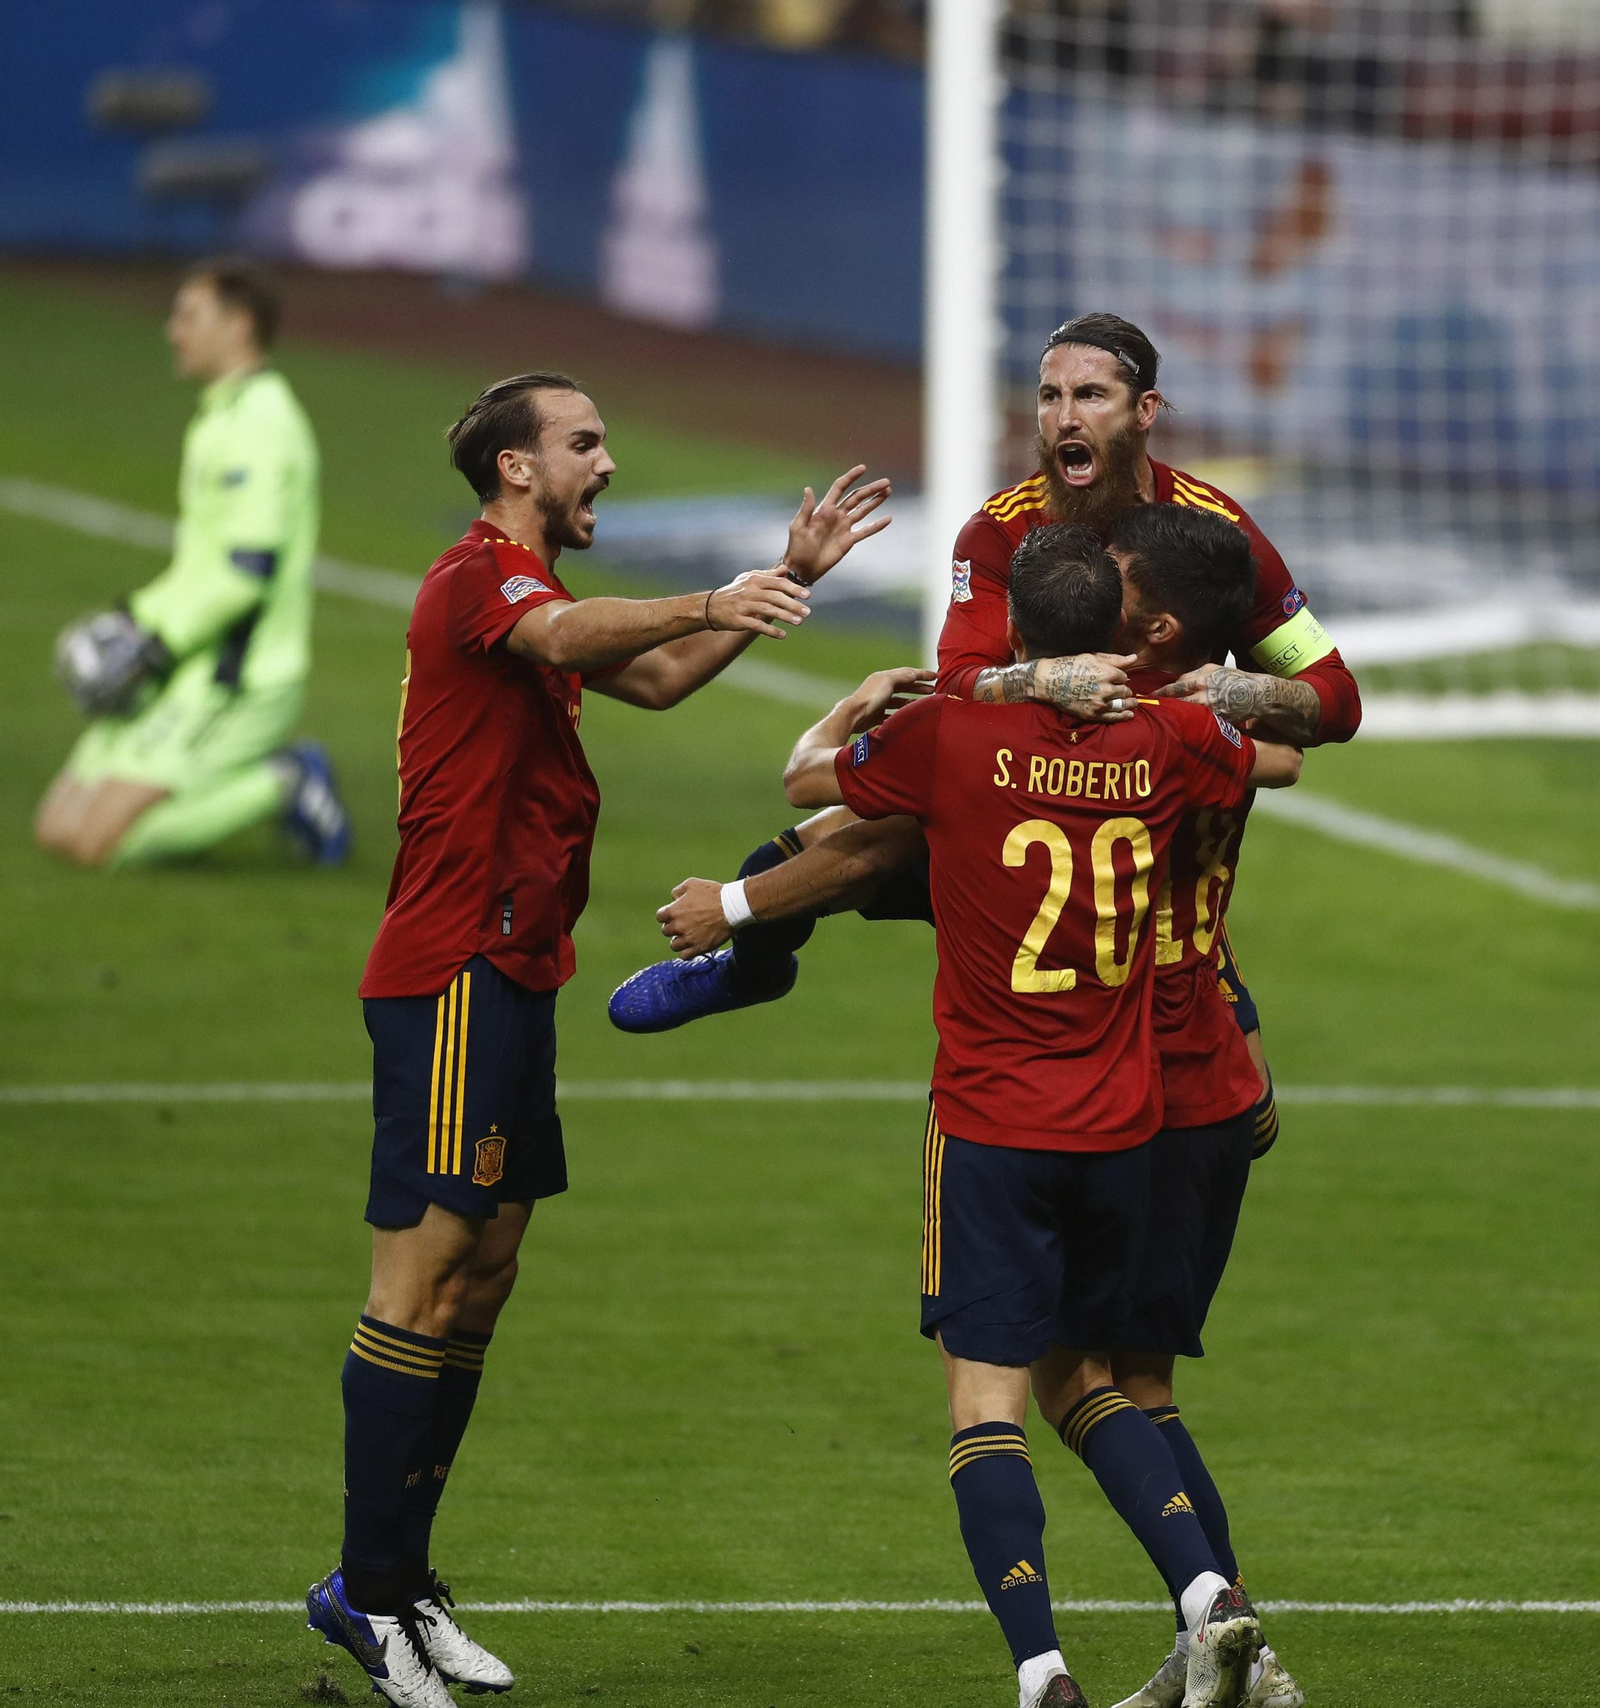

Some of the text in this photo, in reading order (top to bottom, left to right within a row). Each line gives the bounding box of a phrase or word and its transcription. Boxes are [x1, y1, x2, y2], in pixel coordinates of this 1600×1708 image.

[993, 748, 1153, 800] S. ROBERTO
[1002, 817, 1155, 994] 20
[1000, 1574, 1043, 1591] adidas
